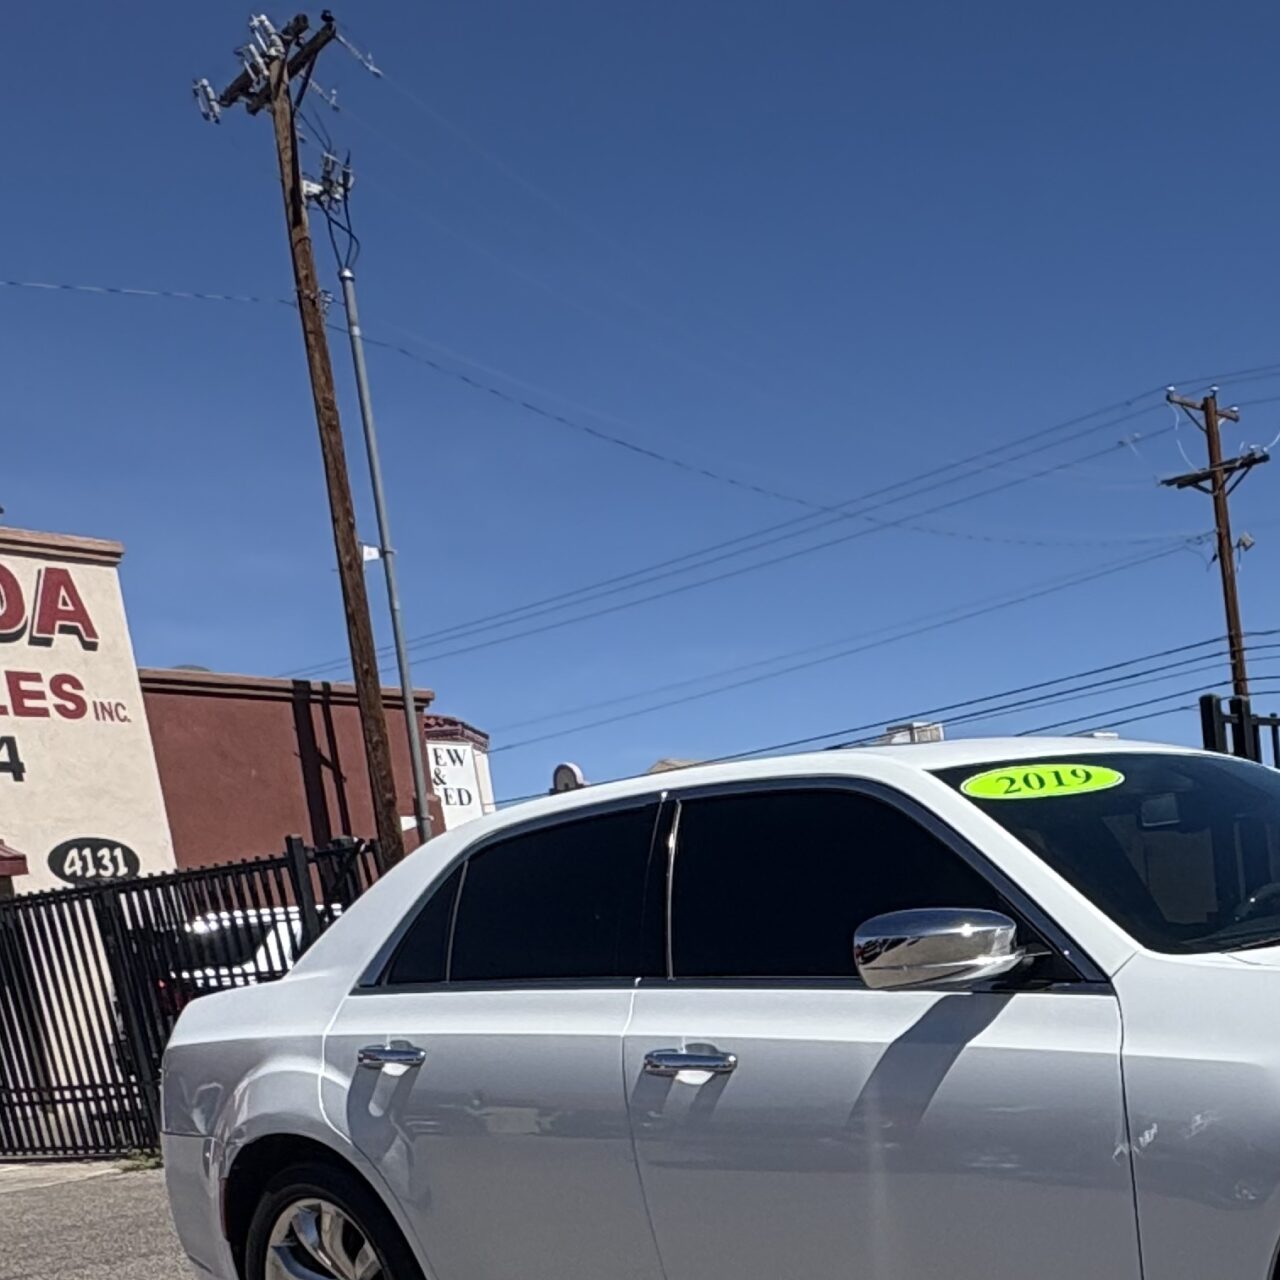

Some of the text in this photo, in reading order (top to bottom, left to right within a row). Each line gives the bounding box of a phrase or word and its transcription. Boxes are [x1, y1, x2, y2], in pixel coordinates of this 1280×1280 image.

[0, 670, 131, 723] ES INC.
[432, 767, 447, 786] &
[996, 768, 1092, 794] 2019
[63, 847, 128, 878] 4131
